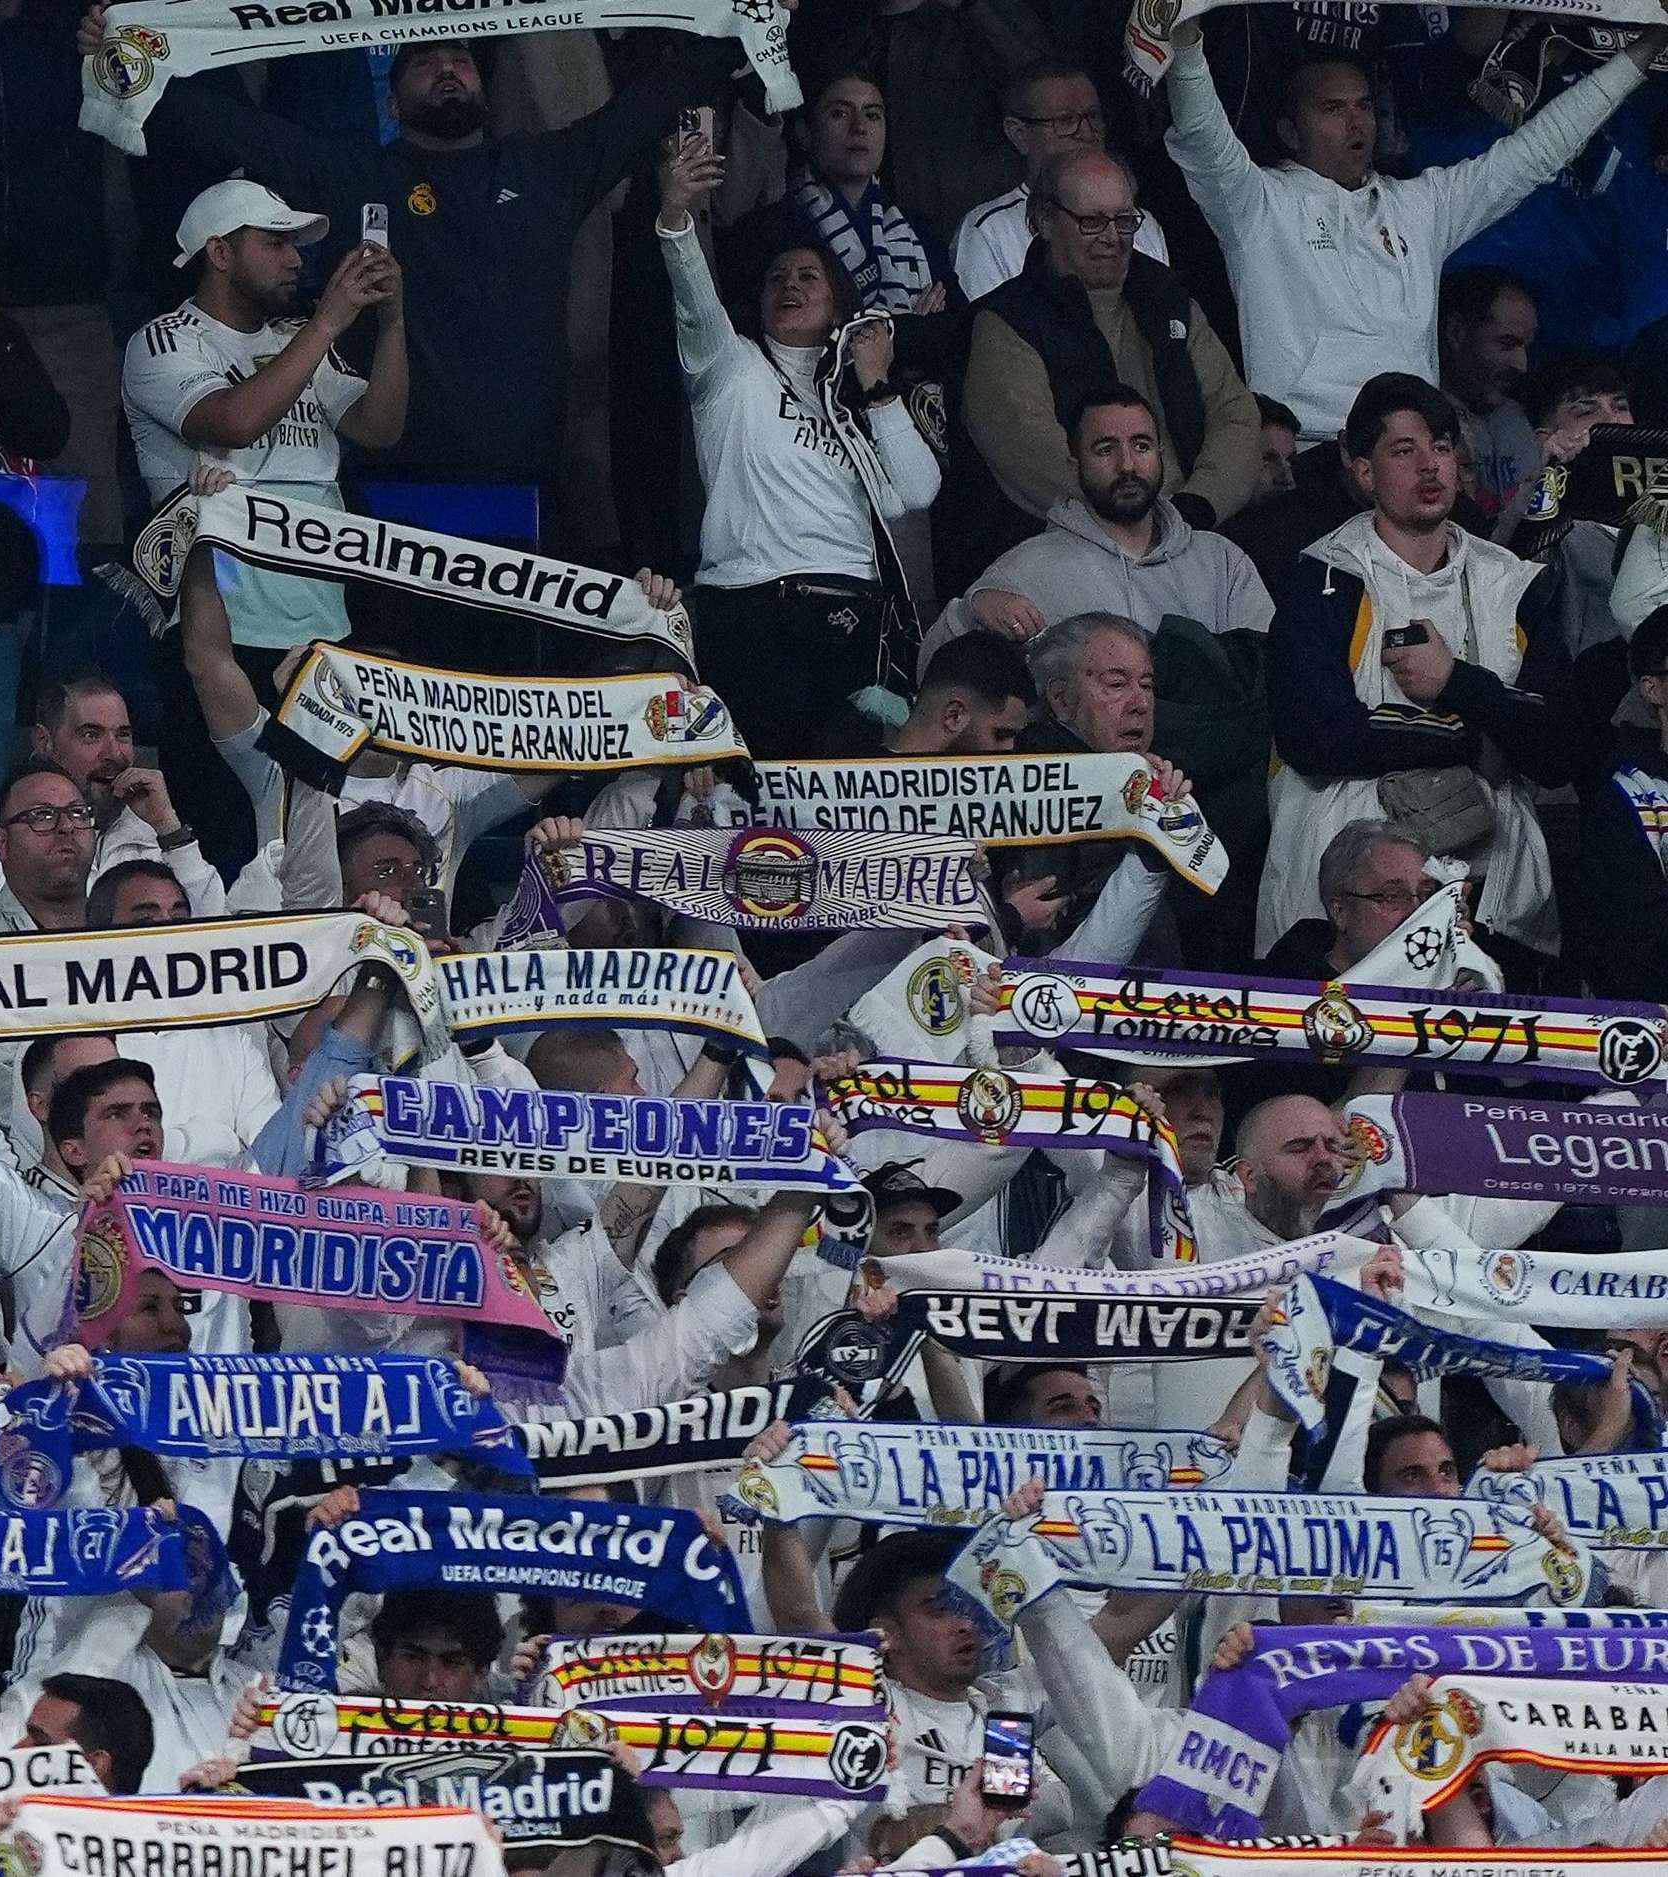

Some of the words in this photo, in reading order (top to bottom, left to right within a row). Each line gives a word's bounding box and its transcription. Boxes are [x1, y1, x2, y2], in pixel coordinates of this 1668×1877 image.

[320, 31, 374, 47] UEFA
[378, 20, 500, 42] CHAMPIONS
[505, 11, 586, 31] LEAGUE
[278, 423, 320, 449] BETTER
[245, 494, 624, 620] Realmadrid
[296, 689, 336, 732] FUNDADA
[333, 721, 356, 739] 1975
[354, 663, 421, 703] PEÑA
[422, 677, 565, 720] MADRIDISTA
[567, 688, 612, 720] DEL
[410, 711, 470, 754] SITIO
[472, 721, 508, 759] DE
[511, 721, 634, 763] ARANJUEZ
[754, 767, 835, 801] PEÑA
[835, 763, 1014, 801] MADRIDISTA
[1023, 761, 1079, 794] DEL
[905, 803, 939, 835] DE
[948, 795, 1103, 839] ARANJUEZ
[581, 842, 723, 893] REAL
[818, 855, 980, 907] MADRID
[730, 912, 802, 930] SANTIAGO
[807, 903, 892, 928] BERNABEU
[65, 940, 310, 1008] MADRID
[441, 951, 549, 1000] HALA
[565, 948, 736, 1002] MADRID!
[553, 986, 611, 1007] nada
[617, 987, 661, 1007] más
[1406, 1006, 1543, 1064] 1971
[379, 1074, 816, 1162] CAMPEONES
[1463, 1103, 1550, 1124] Peña
[456, 1146, 557, 1175] REYES
[568, 1152, 606, 1177] DE
[616, 1155, 735, 1184] EUROPA
[1485, 1123, 1668, 1178] Legan
[217, 1182, 252, 1208] ME
[258, 1188, 307, 1216] HIZO
[395, 1203, 451, 1230] LISTA
[1483, 1177, 1544, 1193] Desde
[125, 1203, 484, 1309] MADRIDISTA
[974, 1431, 1080, 1452] MADRIDISTA
[851, 1463, 870, 1488] 15
[887, 1447, 942, 1508] LA
[1169, 1496, 1222, 1513] PEÑA
[1234, 1498, 1360, 1516] MADRIDISTA
[306, 1505, 433, 1588] Real
[447, 1506, 675, 1570] Madrid
[1095, 1528, 1117, 1556] 15
[1139, 1513, 1209, 1574] LA
[1229, 1515, 1402, 1581] PALOMA
[1433, 1538, 1453, 1567] 15
[441, 1564, 482, 1583] UEFA
[483, 1564, 581, 1592] CHAMPIONS
[583, 1572, 648, 1599] LEAGUE
[755, 1642, 847, 1702] 1971
[1255, 1634, 1439, 1691] REYES
[1451, 1634, 1538, 1672] DE
[648, 1716, 780, 1778] 1971
[1179, 1729, 1269, 1799] RMCF
[1563, 1740, 1618, 1756] HALA
[432, 1768, 613, 1820] Madrid
[157, 1818, 220, 1838] PEÑA
[231, 1823, 376, 1840] MADRIDISTA
[55, 1831, 358, 1877] CARABANCHEL
